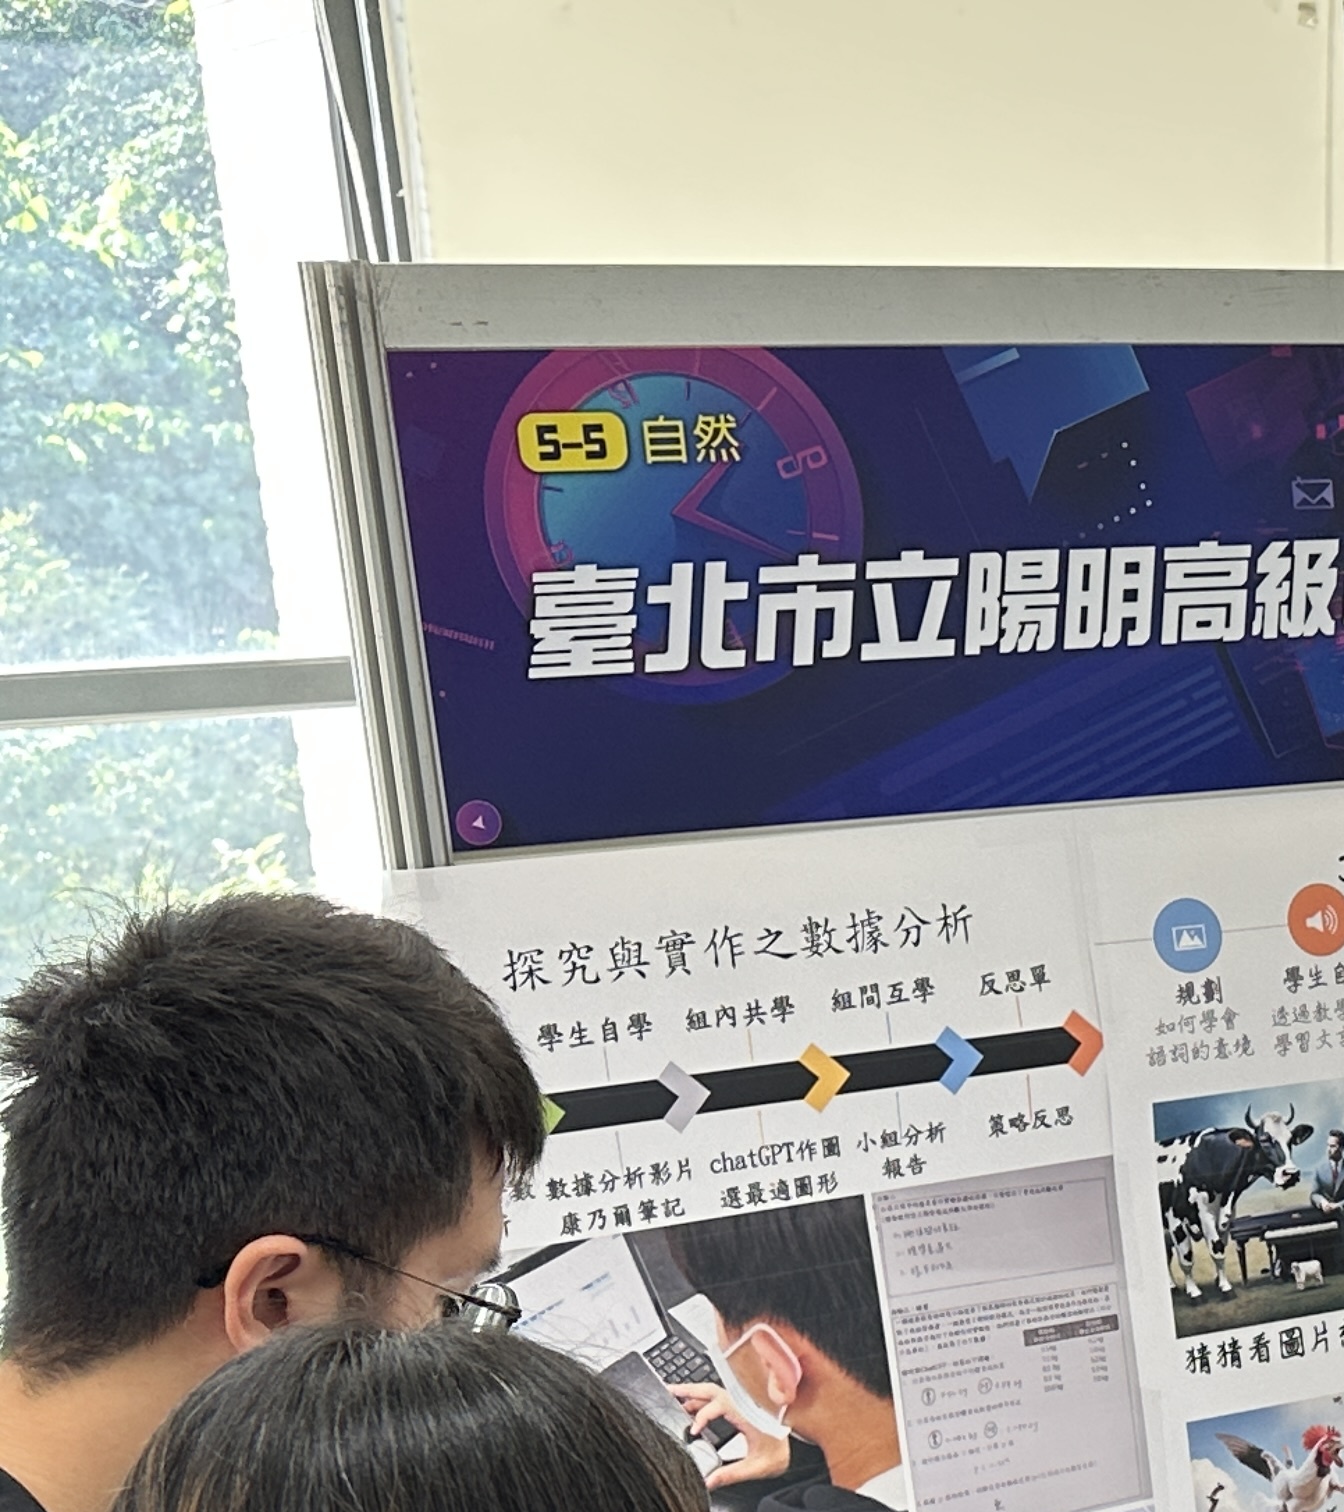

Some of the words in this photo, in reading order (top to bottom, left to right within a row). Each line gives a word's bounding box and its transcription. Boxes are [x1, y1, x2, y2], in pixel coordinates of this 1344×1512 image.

[536, 423, 611, 465] 5-5
[643, 411, 743, 466] 自然
[501, 902, 975, 993] 探究與實作之數據分析
[537, 1012, 654, 1052] 學生自學
[685, 995, 796, 1033] 組內共學
[830, 976, 936, 1013] 組間互學
[978, 963, 1052, 998] 反思單
[1154, 1006, 1240, 1037] 如何學會
[1175, 975, 1224, 1006] 規劃
[546, 1156, 693, 1202] 數據分析影片
[856, 1120, 948, 1155] 小組分析
[988, 1107, 1075, 1140] 策略反思
[561, 1198, 686, 1237] 康乃爾筆記
[720, 1171, 839, 1211] 選最適圖形
[882, 1154, 928, 1180] 報告
